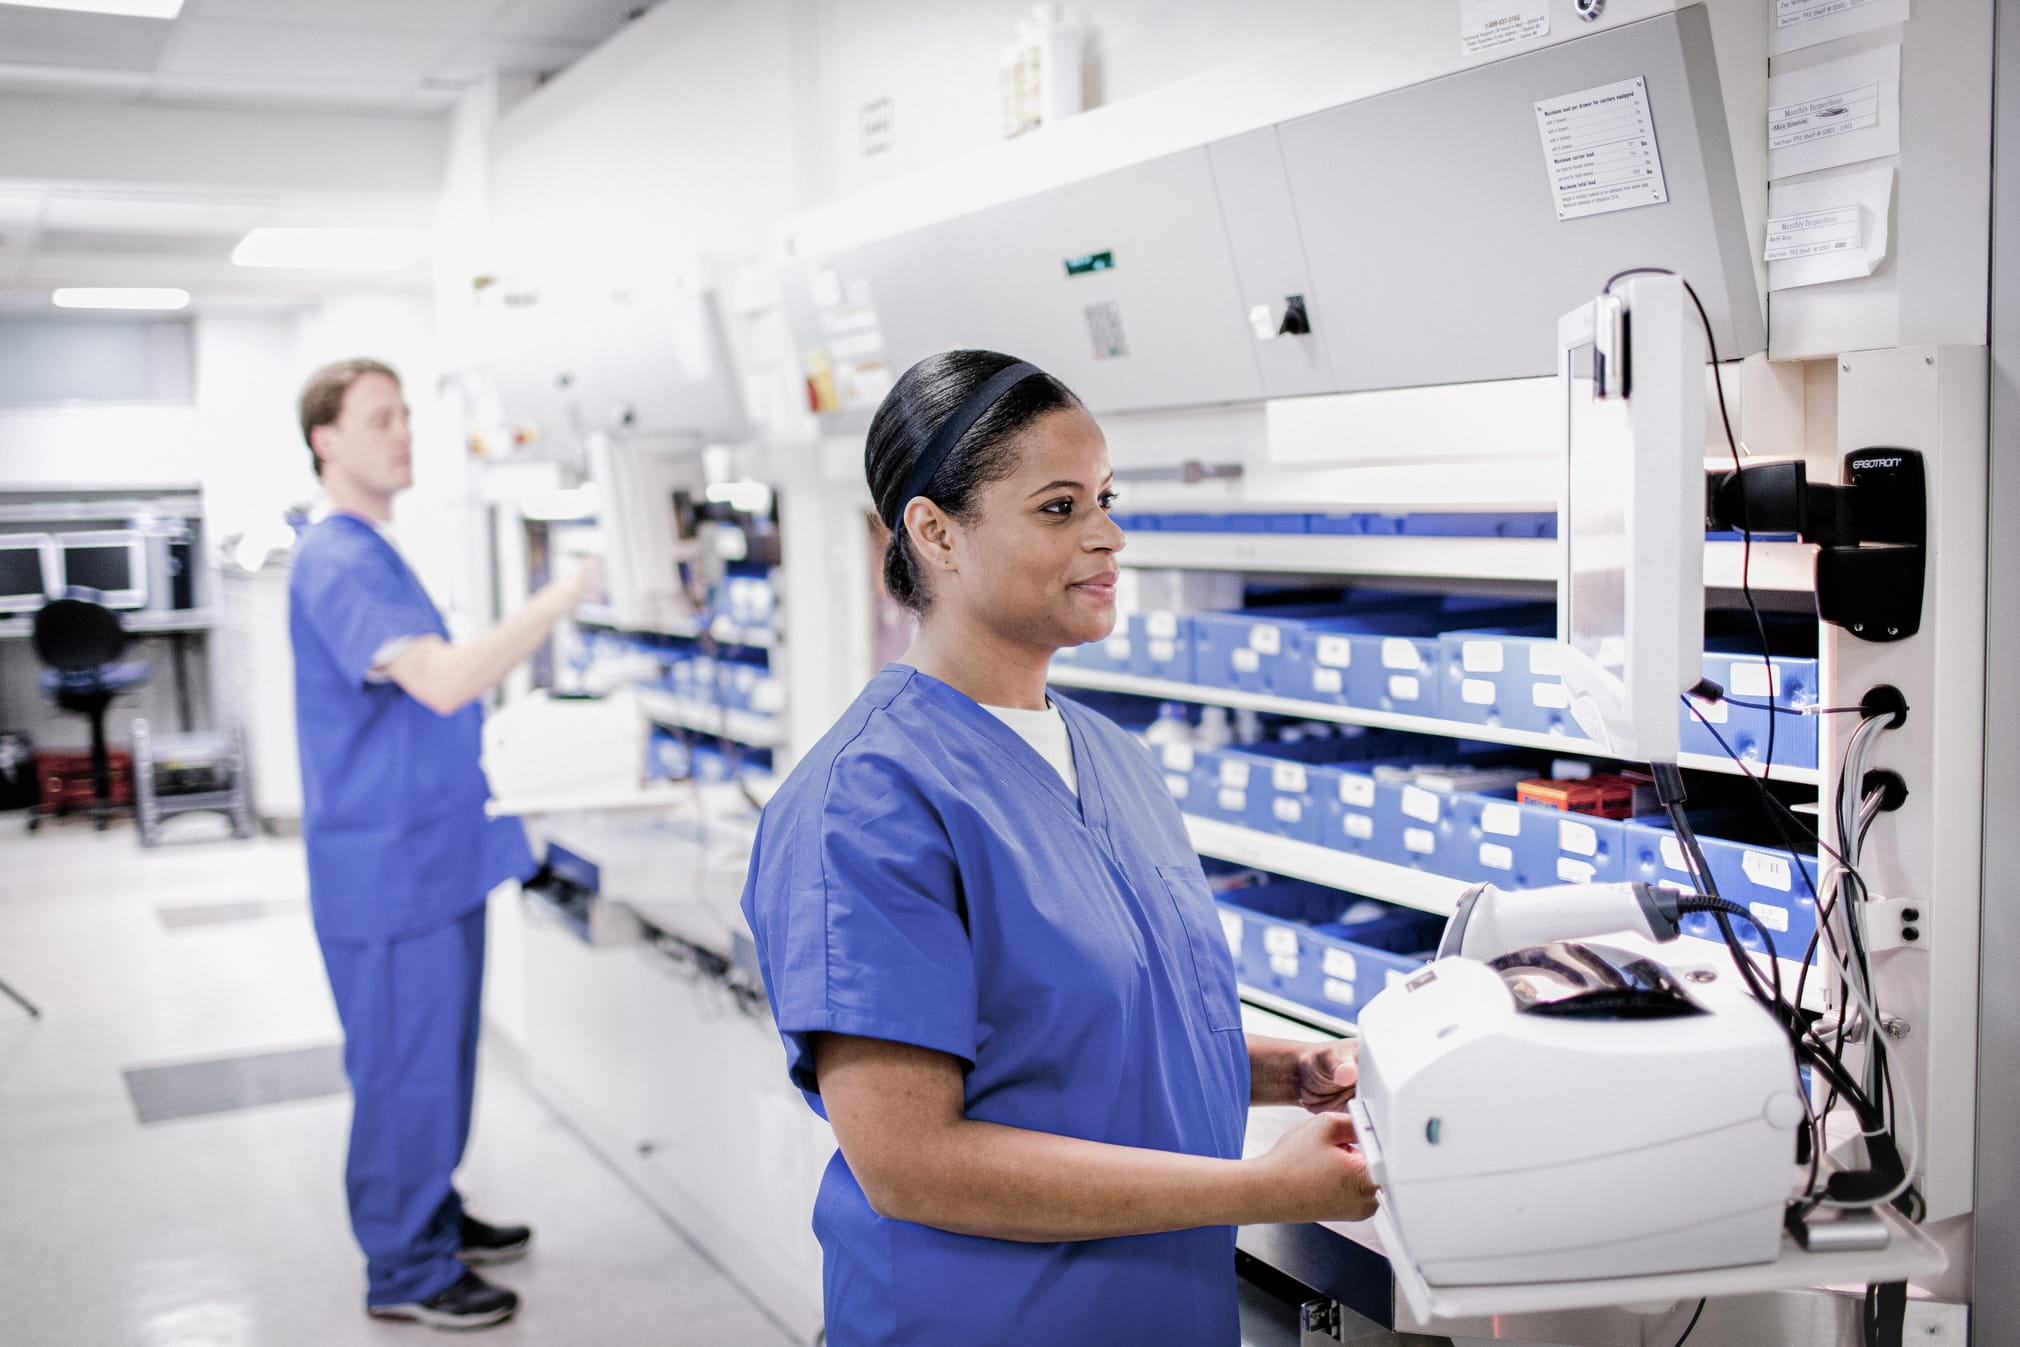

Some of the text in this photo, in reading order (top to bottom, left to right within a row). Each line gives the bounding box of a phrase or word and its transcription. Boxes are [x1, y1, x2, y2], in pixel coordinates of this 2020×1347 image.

[1616, 90, 1634, 100] equipped
[1784, 98, 1843, 117] Monthly Inspections
[1803, 131, 1816, 140] Shelf
[1781, 215, 1838, 230] Monthly Inspections
